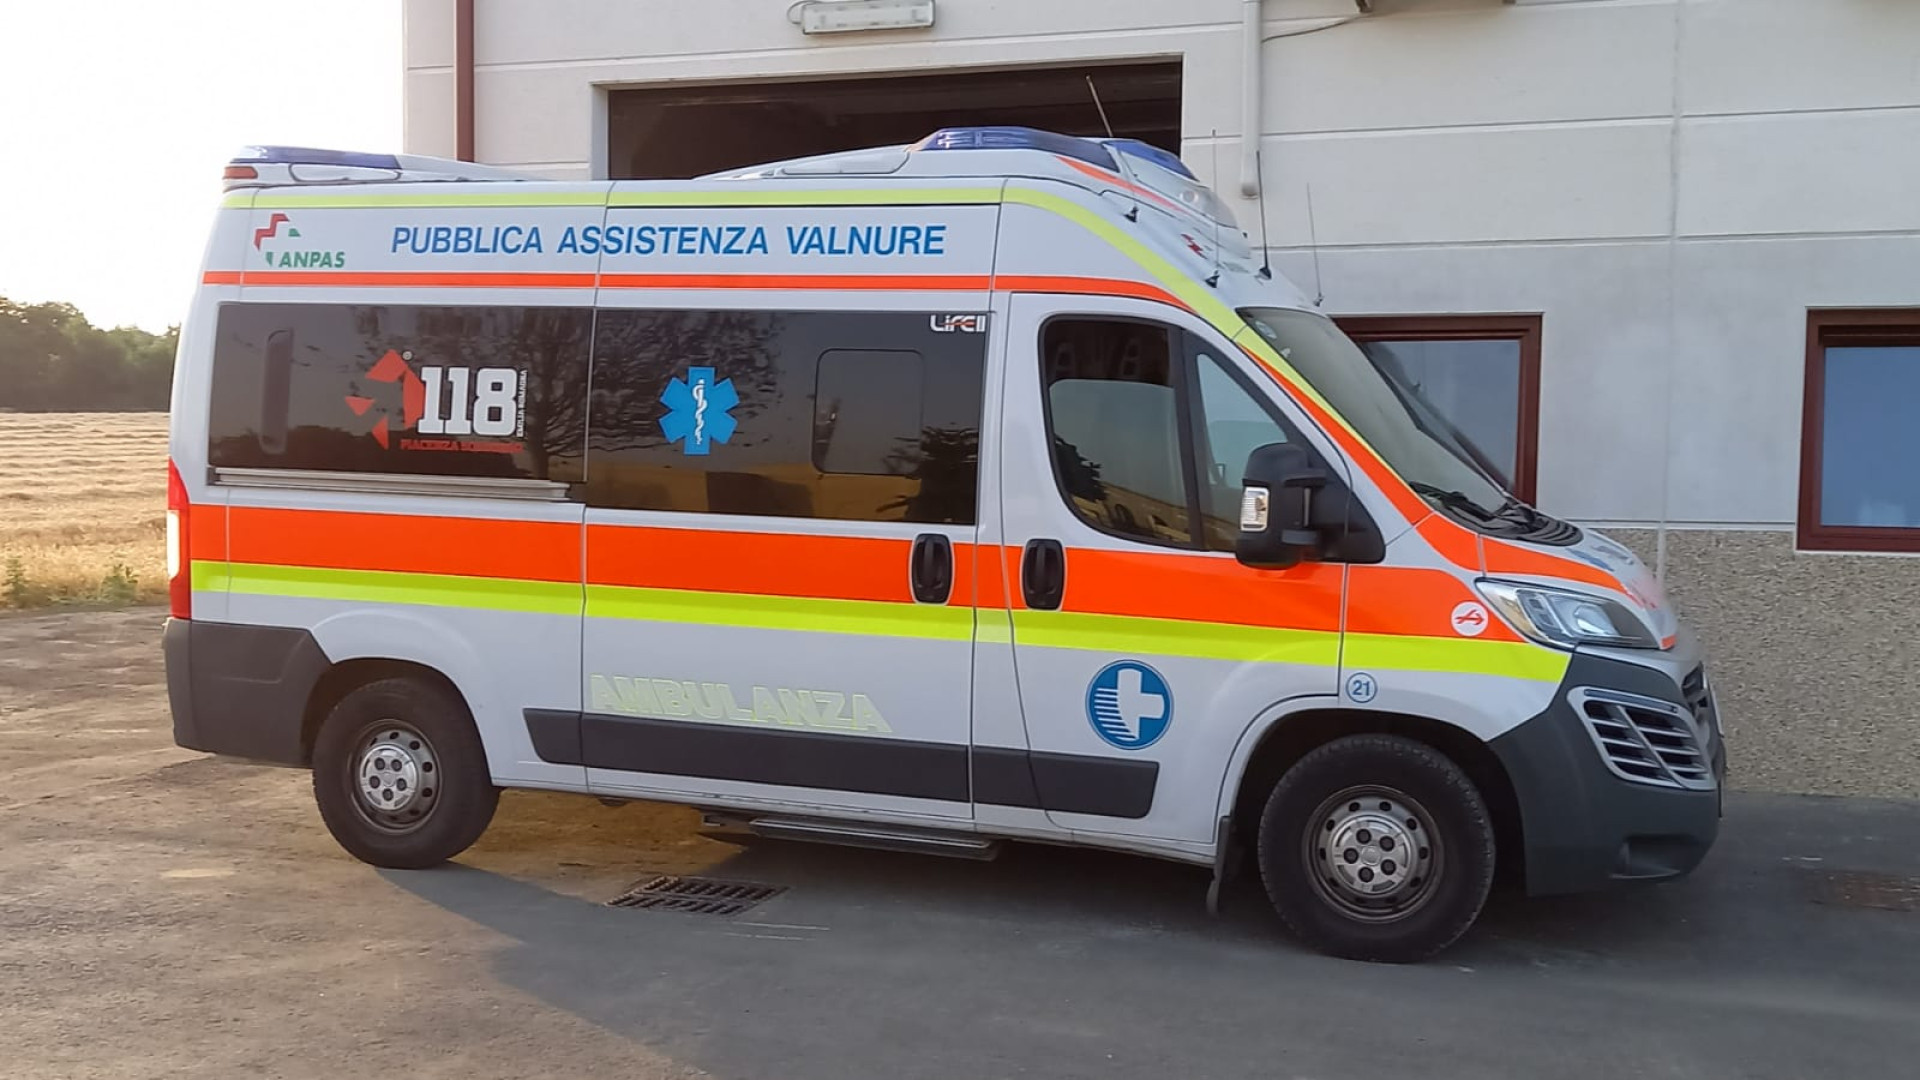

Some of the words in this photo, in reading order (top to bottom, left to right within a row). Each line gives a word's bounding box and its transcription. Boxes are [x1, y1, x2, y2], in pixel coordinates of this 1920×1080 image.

[391, 226, 543, 254] PUBBLICA
[556, 226, 768, 255] ASSISTENZA
[786, 225, 947, 255] VALNURE
[279, 251, 345, 268] ANPAS
[417, 366, 518, 436] 118
[1352, 679, 1371, 697] 21
[590, 674, 893, 733] AMBULANZA
